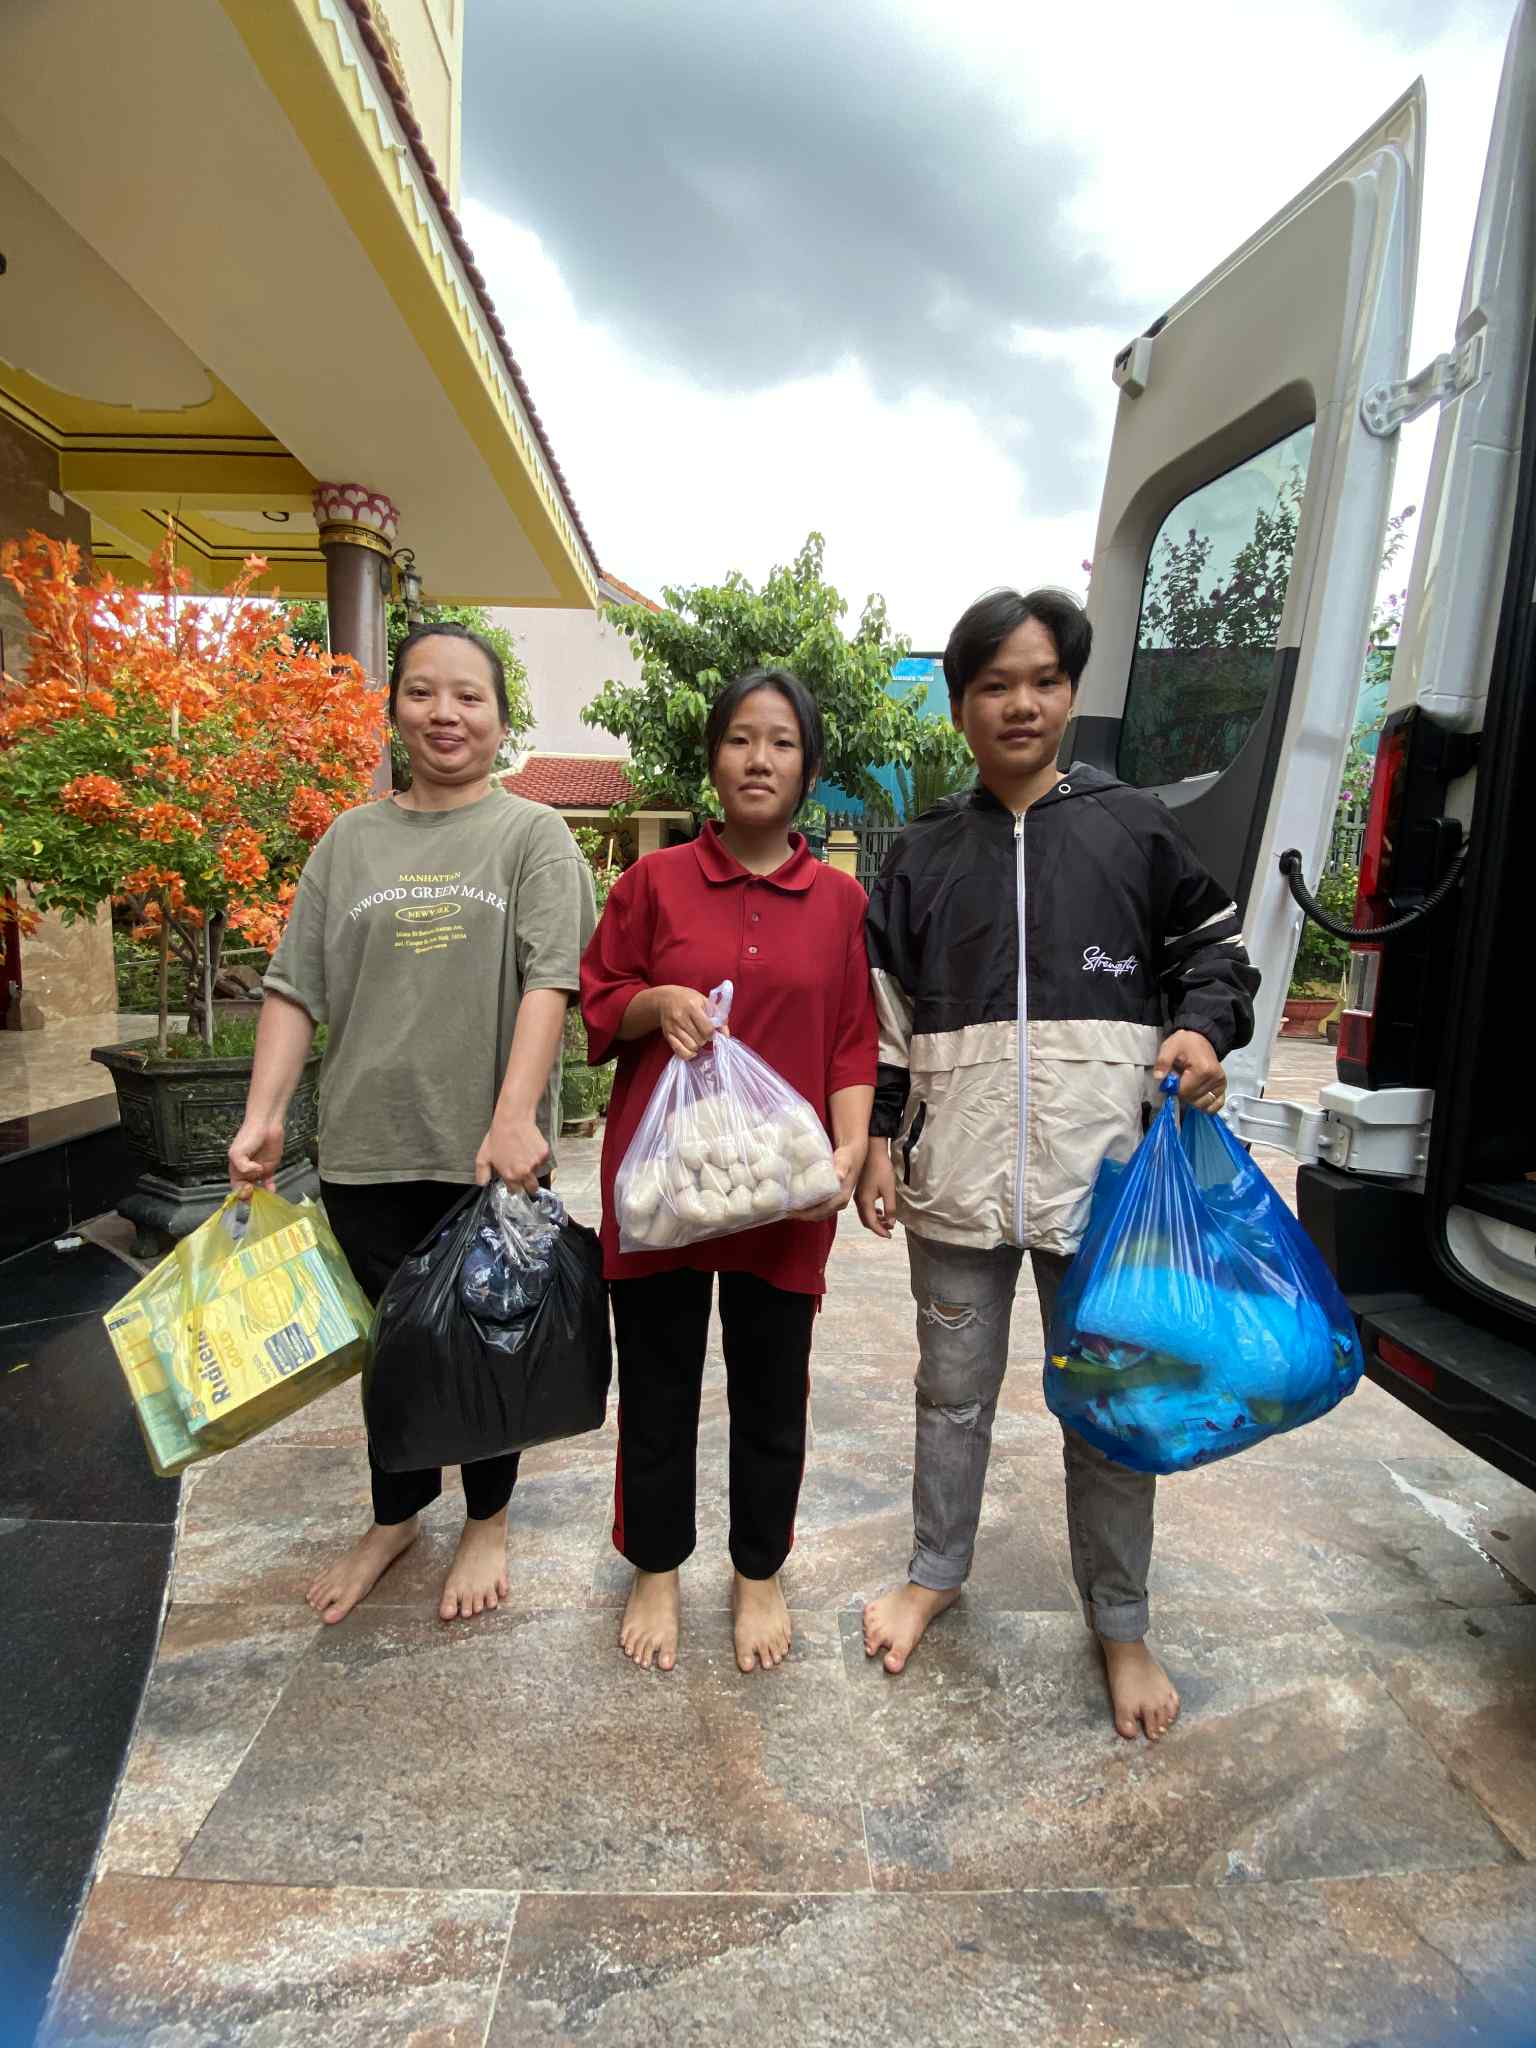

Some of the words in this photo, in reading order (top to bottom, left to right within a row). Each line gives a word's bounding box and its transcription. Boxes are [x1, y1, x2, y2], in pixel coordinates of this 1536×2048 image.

[399, 872, 461, 883] MANHATTAN
[349, 886, 407, 921] INWOOD
[411, 885, 460, 899] GREEN
[461, 885, 508, 913] MARK
[1081, 946, 1139, 977] Strength
